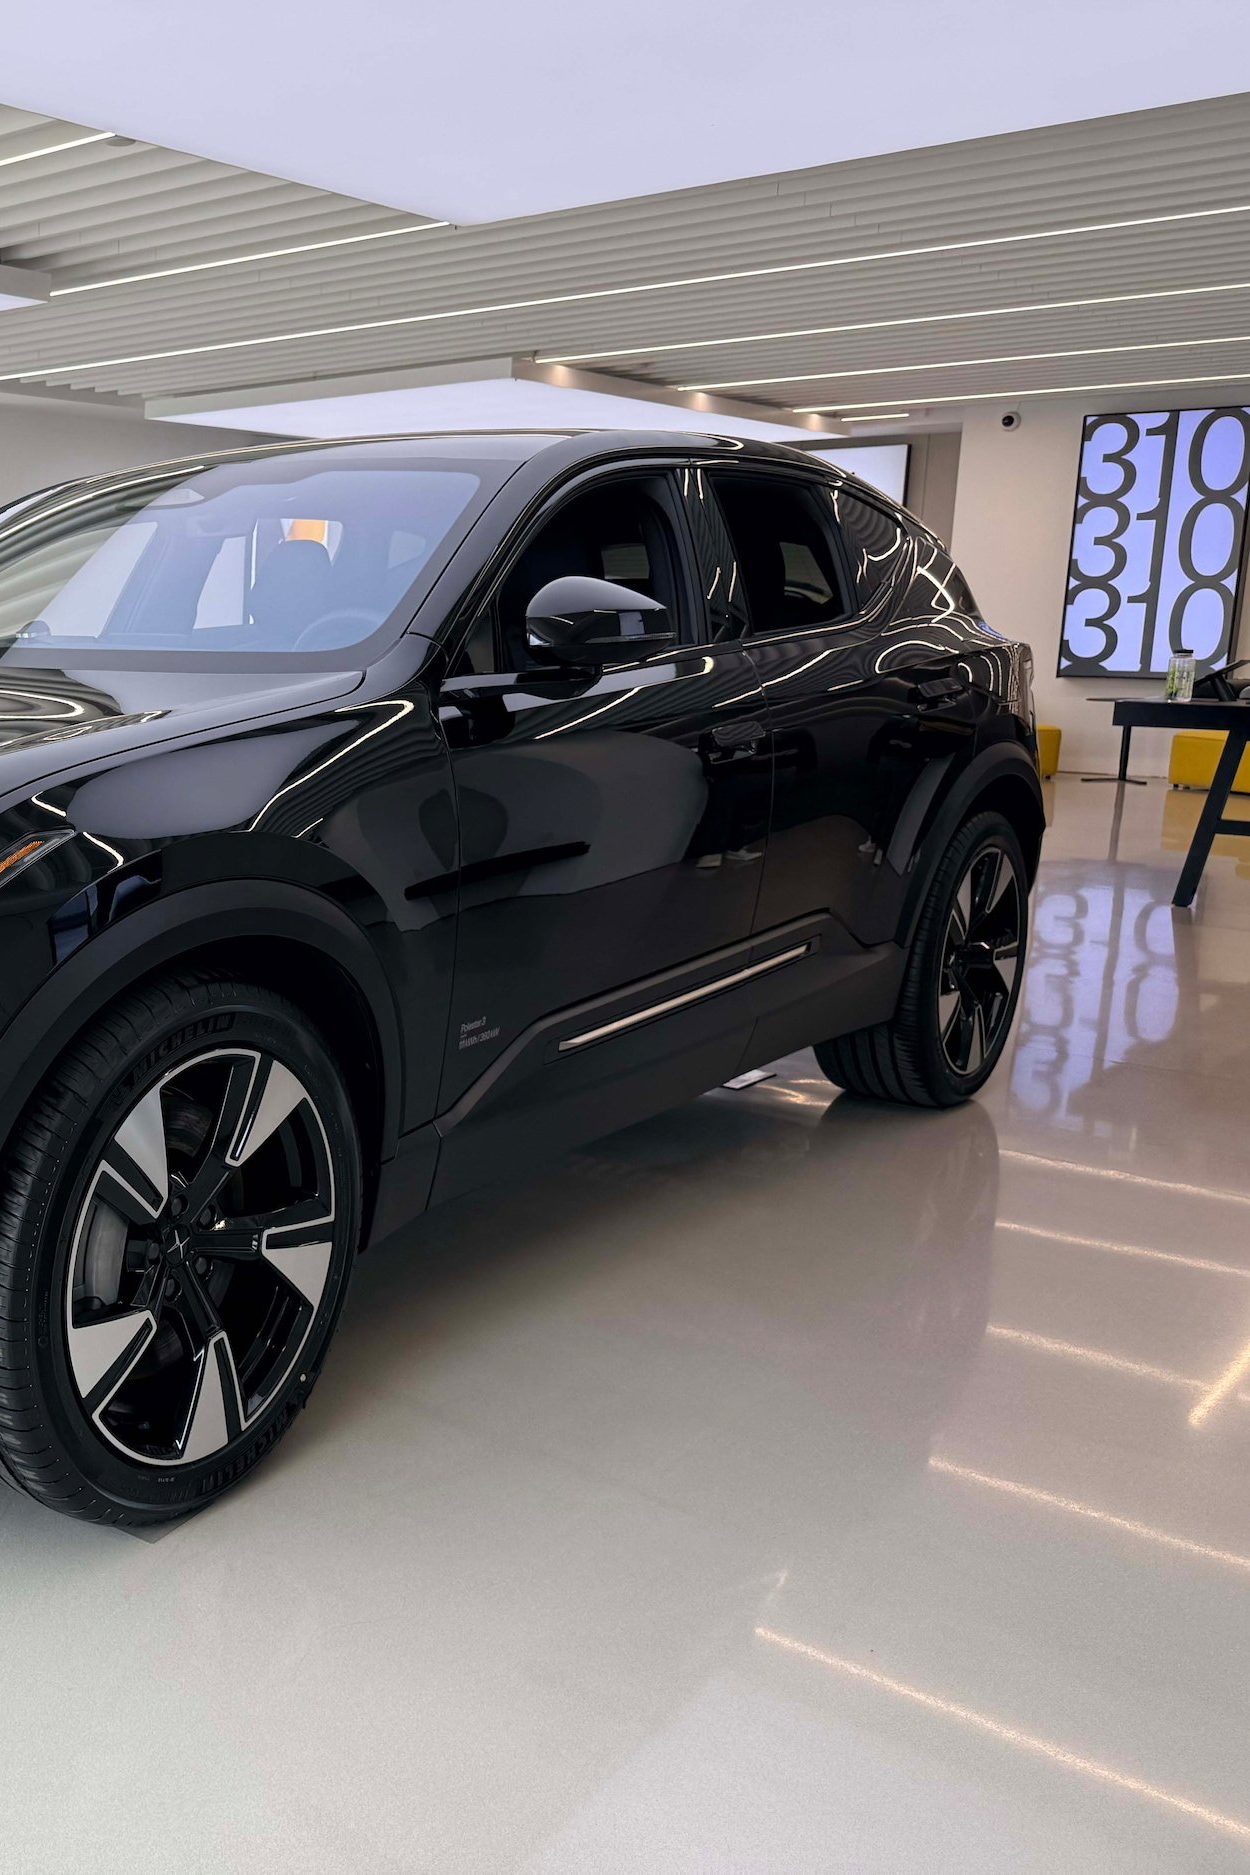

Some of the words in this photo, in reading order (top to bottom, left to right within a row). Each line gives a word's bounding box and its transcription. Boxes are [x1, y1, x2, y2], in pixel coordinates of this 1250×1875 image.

[1078, 408, 1250, 501] 310
[1069, 495, 1246, 586] 310
[1060, 579, 1236, 669] 310
[132, 1013, 234, 1084] MICHELIN
